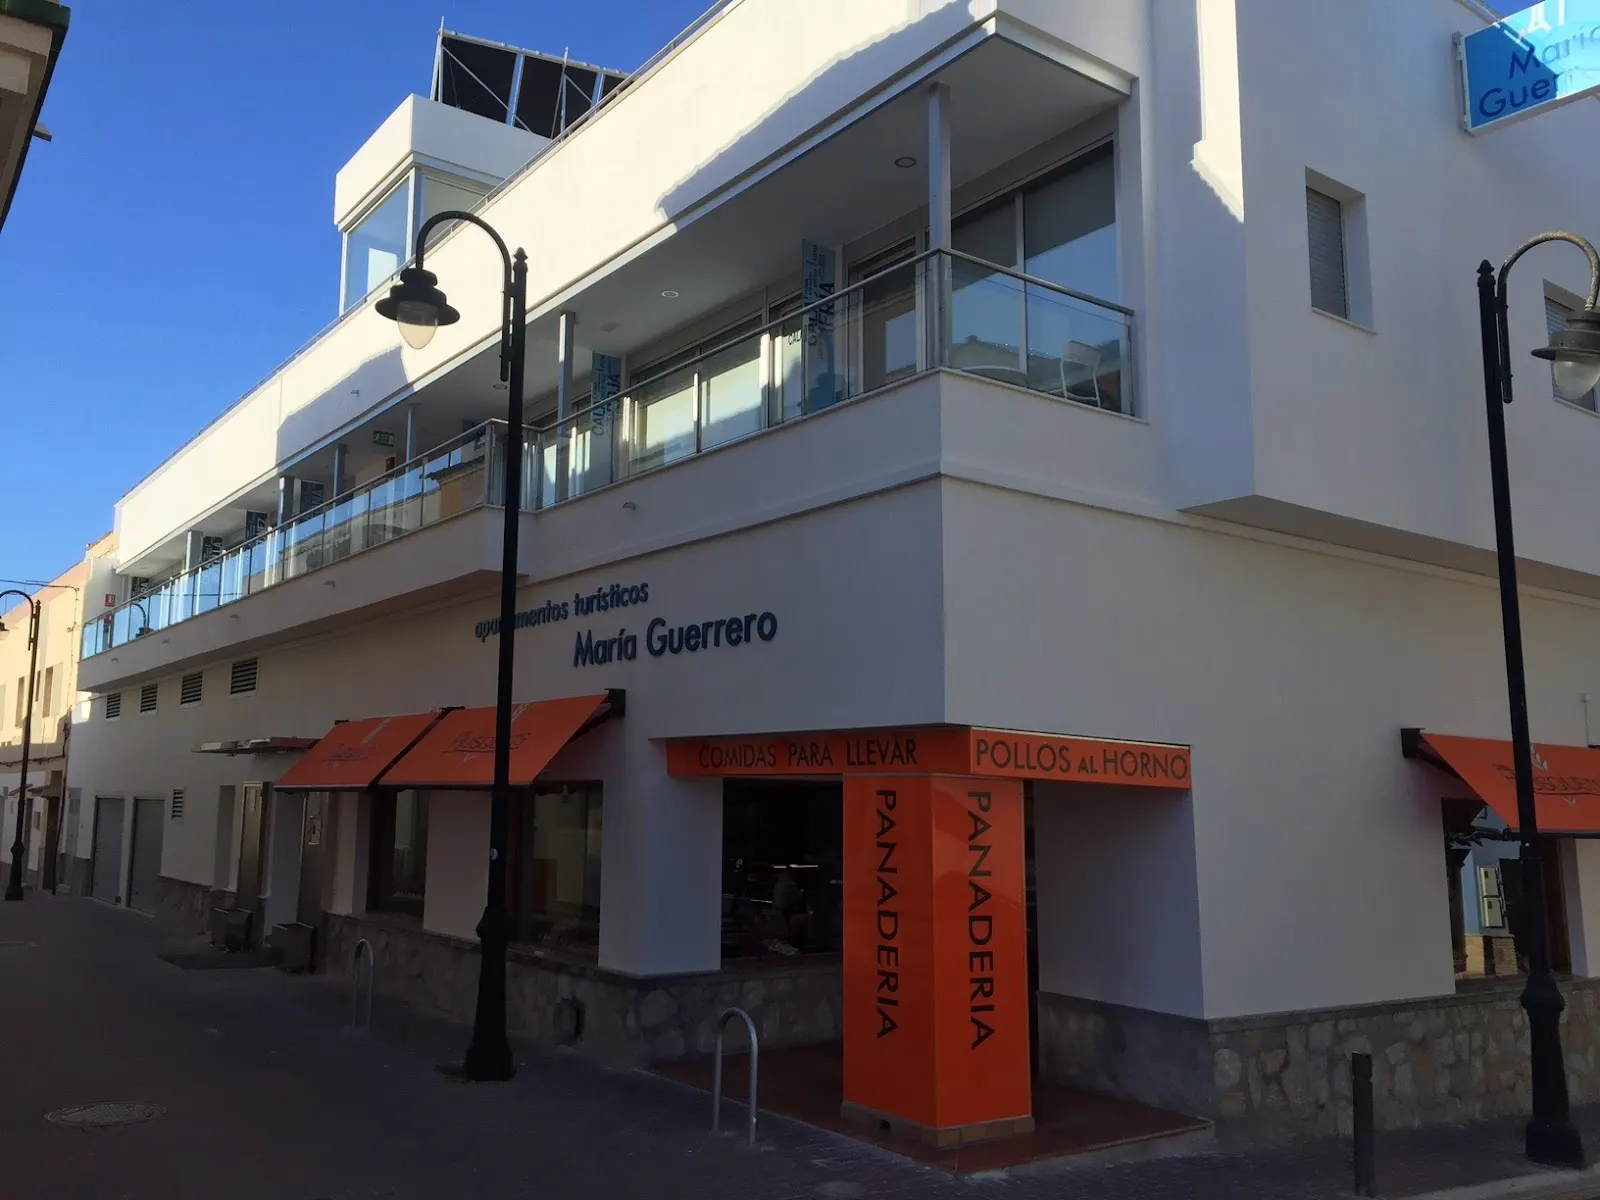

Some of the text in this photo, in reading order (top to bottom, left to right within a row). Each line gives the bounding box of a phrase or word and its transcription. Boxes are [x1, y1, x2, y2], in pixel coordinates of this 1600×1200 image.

[475, 582, 649, 643] apamentos turísticos
[573, 611, 778, 667] María Guerrero
[699, 738, 918, 768] COMIDAS PARA LLEVAR
[976, 738, 1188, 780] POLLOS AL HORNO
[875, 789, 900, 1039] PANADERIA
[967, 790, 996, 1050] PANADERIA
